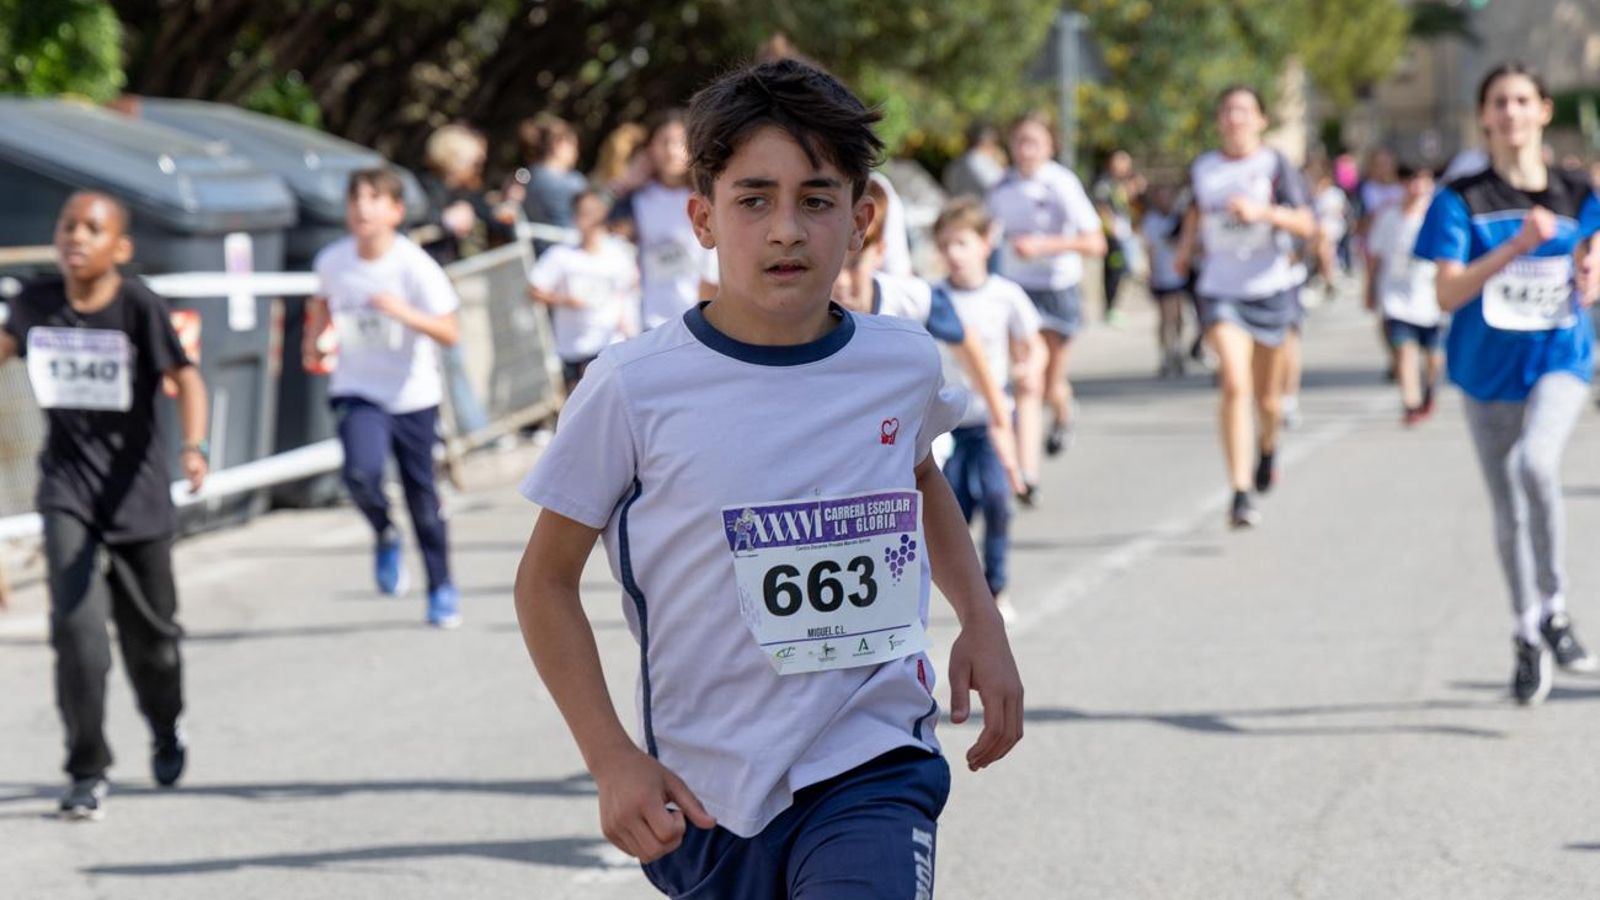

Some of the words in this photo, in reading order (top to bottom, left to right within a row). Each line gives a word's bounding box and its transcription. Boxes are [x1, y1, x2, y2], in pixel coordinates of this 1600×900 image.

[48, 357, 119, 384] 1340
[824, 504, 866, 521] CARRERA
[868, 498, 911, 515] ESCOLAR
[753, 510, 823, 544] XXXVI
[834, 520, 848, 536] LA
[856, 513, 897, 533] GLORIA
[763, 555, 878, 617] 663
[807, 626, 832, 638] MIGUEL
